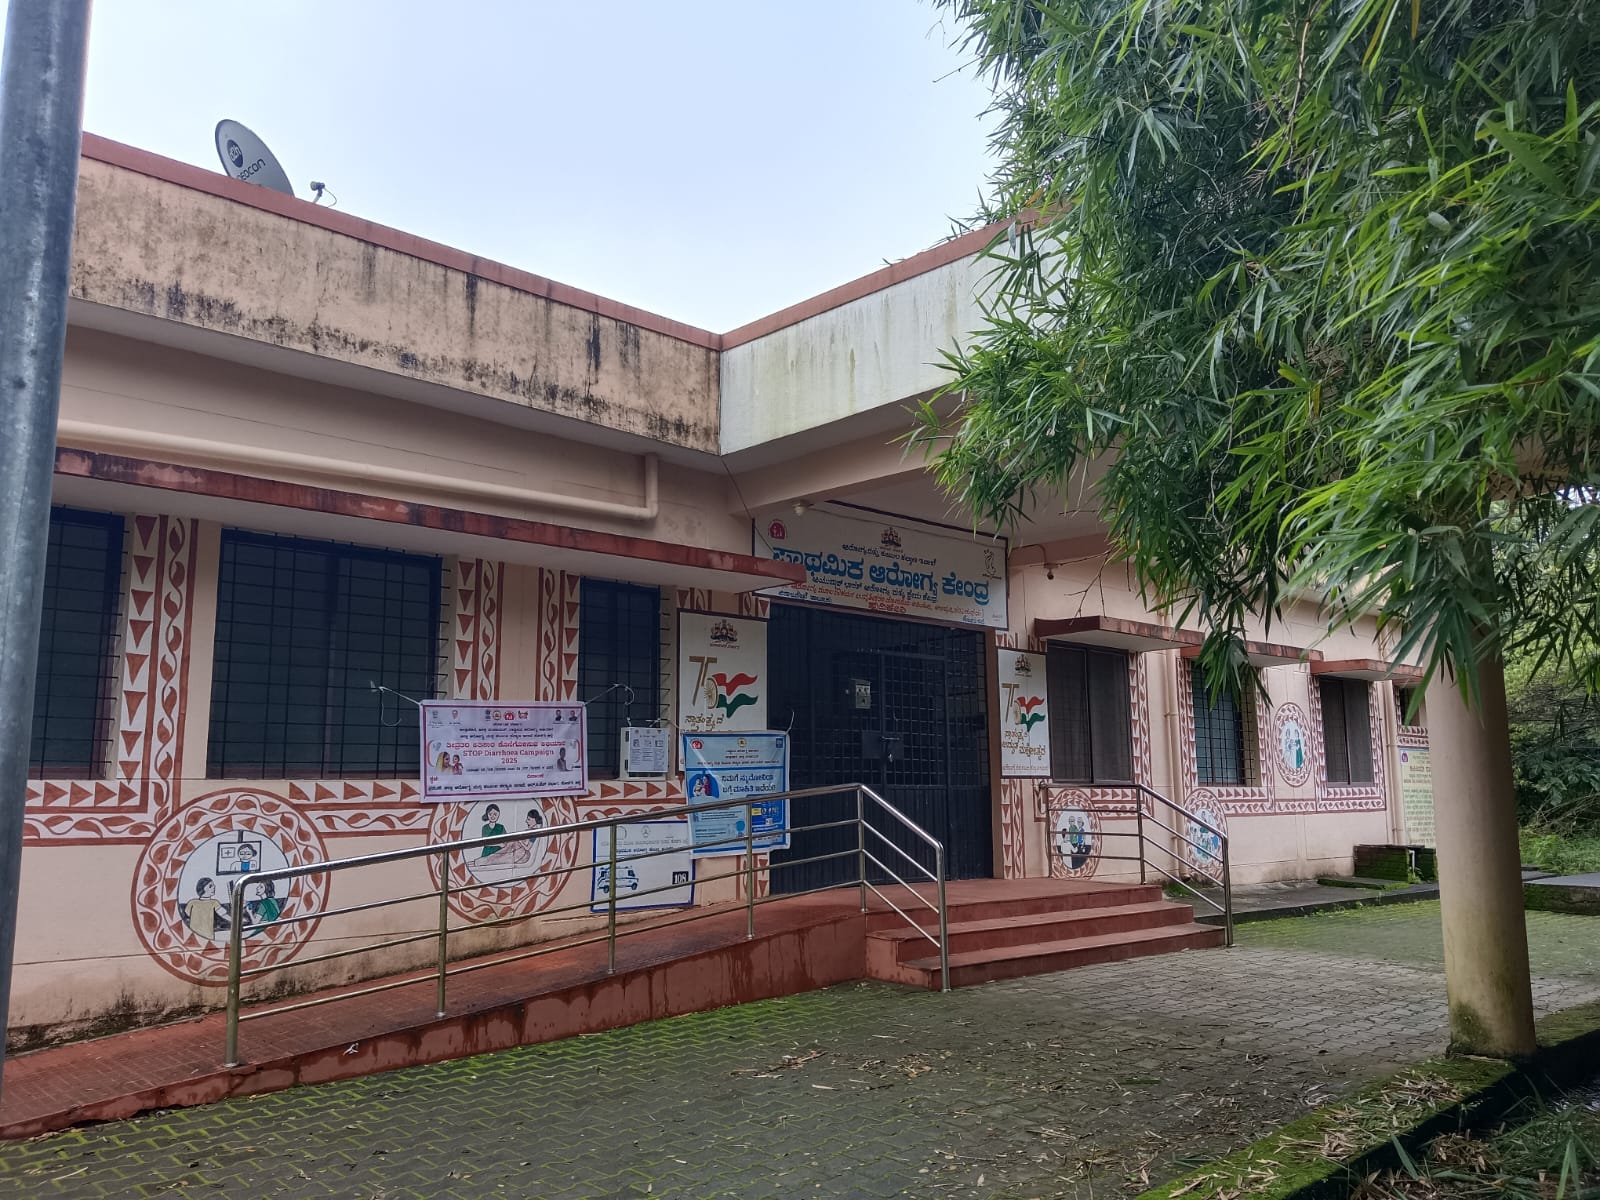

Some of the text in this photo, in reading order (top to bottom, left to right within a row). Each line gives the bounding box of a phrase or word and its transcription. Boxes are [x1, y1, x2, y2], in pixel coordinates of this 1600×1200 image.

[870, 561, 939, 597] ಆರೋಗ್ಯ
[942, 571, 990, 605] ಕೇಂದ್ರ
[463, 749, 483, 757] STOP
[520, 749, 555, 757] Campaign
